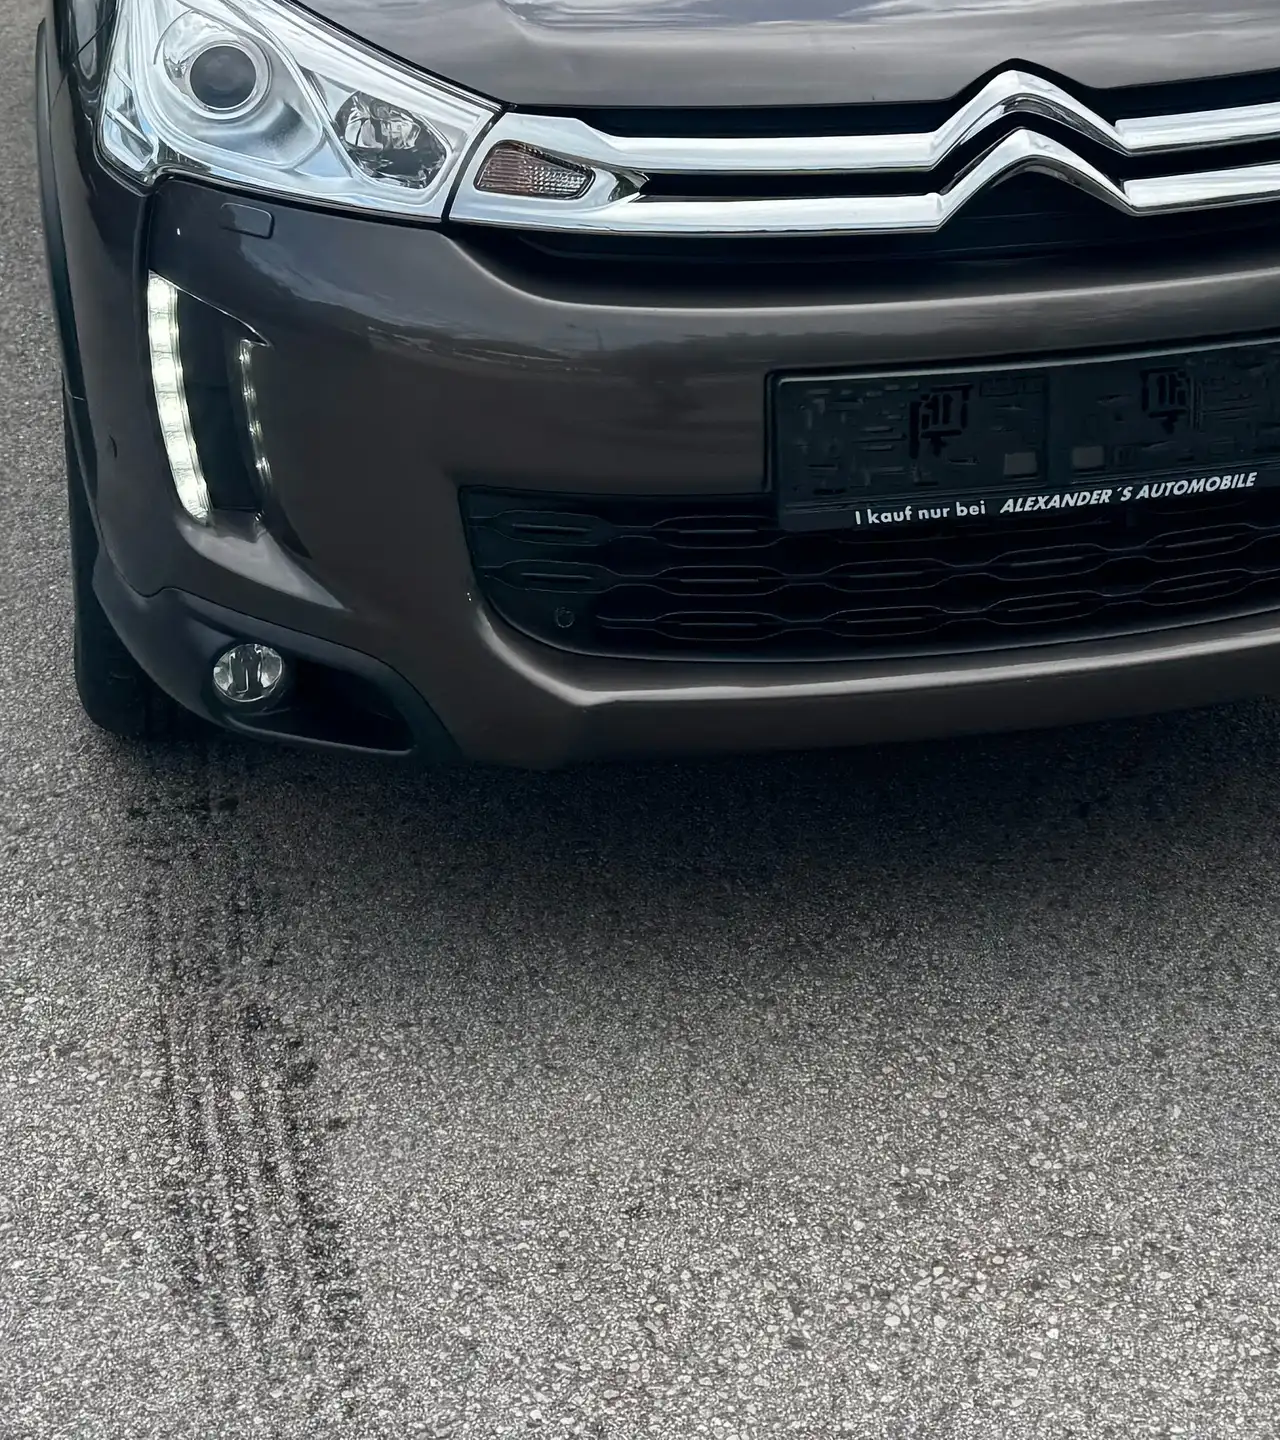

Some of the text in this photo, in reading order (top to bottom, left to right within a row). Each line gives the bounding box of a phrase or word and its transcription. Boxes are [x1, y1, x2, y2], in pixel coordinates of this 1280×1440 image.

[855, 511, 861, 525] I
[867, 505, 913, 524] kauf
[918, 506, 950, 520] nur
[955, 500, 986, 517] bei
[1000, 489, 1113, 514] ALEXANDER
[1135, 471, 1258, 500] AUTOMOBILE
